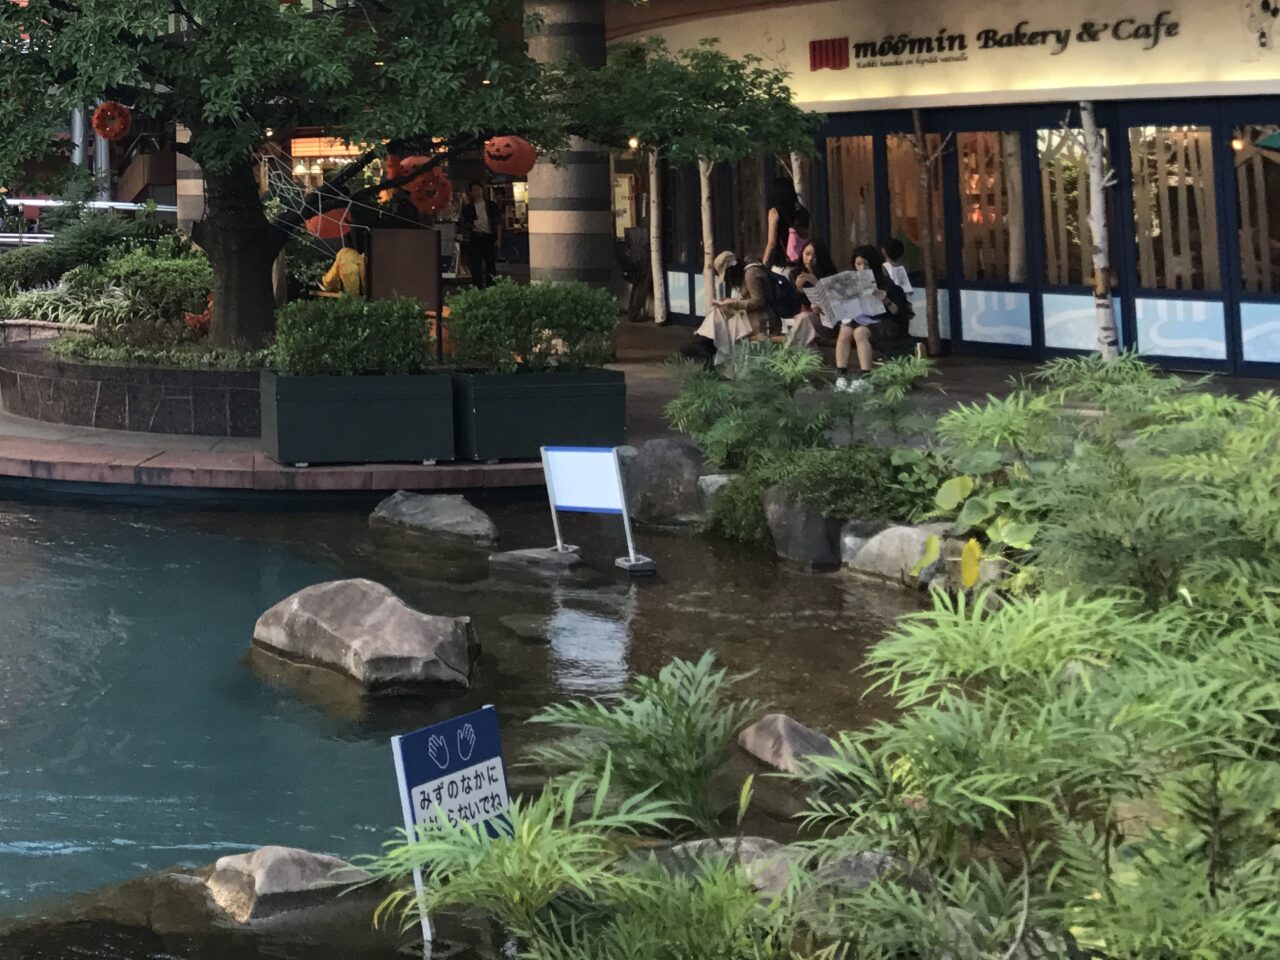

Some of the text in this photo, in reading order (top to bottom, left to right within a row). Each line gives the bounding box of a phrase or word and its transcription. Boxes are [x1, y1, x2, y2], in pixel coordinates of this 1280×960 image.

[976, 20, 1071, 56] Bakery
[1076, 19, 1109, 43] &
[1111, 10, 1180, 51] Cafe
[420, 766, 498, 810] みずのなかに
